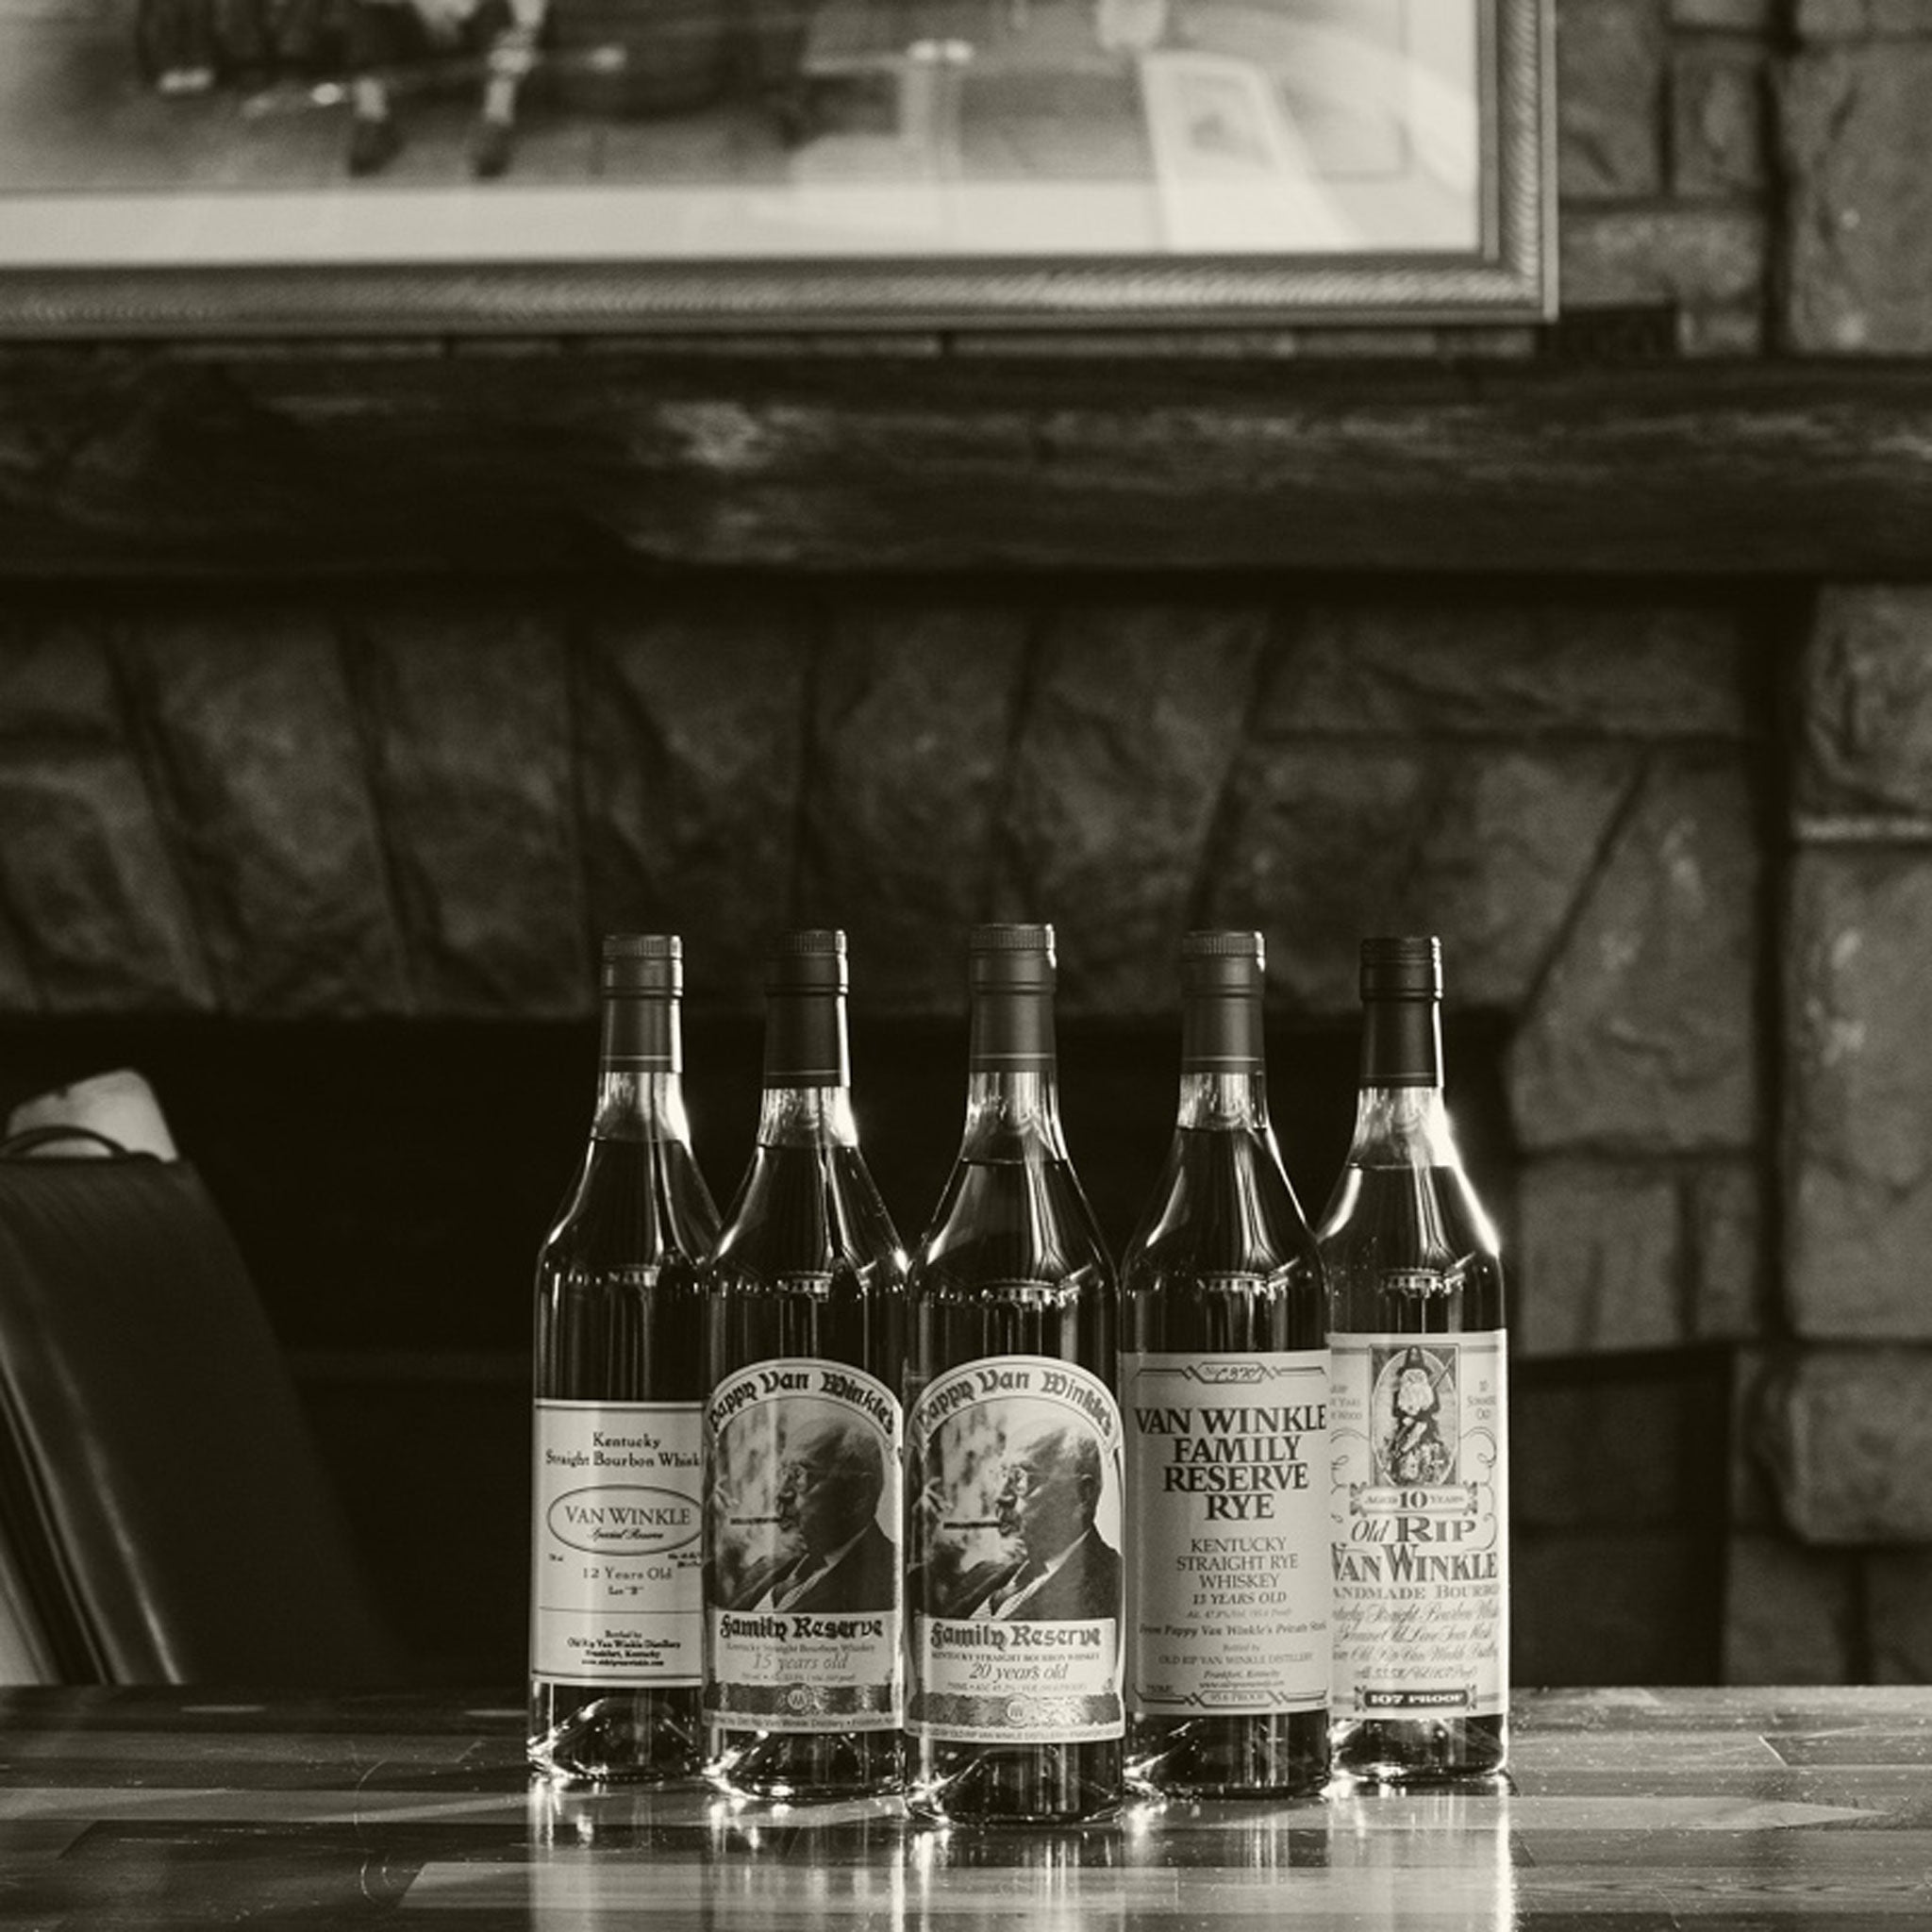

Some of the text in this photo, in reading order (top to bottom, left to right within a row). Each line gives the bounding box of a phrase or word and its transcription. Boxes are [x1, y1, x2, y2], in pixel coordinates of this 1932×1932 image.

[758, 1371, 809, 1393] Van
[975, 1369, 1030, 1393] Van
[1133, 1404, 1326, 1435] VAN WINKLE
[592, 1431, 660, 1449] Kentucky
[1173, 1434, 1302, 1463] FAMILY
[545, 1449, 590, 1468] Straight
[593, 1451, 655, 1467] Bourbon
[1163, 1462, 1309, 1492] RESERVE
[1204, 1492, 1274, 1521] RYE
[1399, 1491, 1428, 1509] 10
[565, 1505, 691, 1525] VAN WINKLE
[1351, 1515, 1476, 1542] Old RIP
[1191, 1536, 1287, 1553] KENTUCKY
[1175, 1553, 1298, 1572] STRAIGHT RYE
[1331, 1541, 1498, 1582] VAN WINKLE
[583, 1567, 672, 1580] 12 Years Old
[1199, 1574, 1280, 1589] WHISKEY
[1210, 1592, 1255, 1605] YEARS
[1258, 1591, 1287, 1603] OLD
[720, 1614, 883, 1641] Family Reserve
[930, 1621, 1102, 1651] Family Reserve
[753, 1652, 849, 1676] 15 years old
[969, 1661, 1069, 1683] 20 years old
